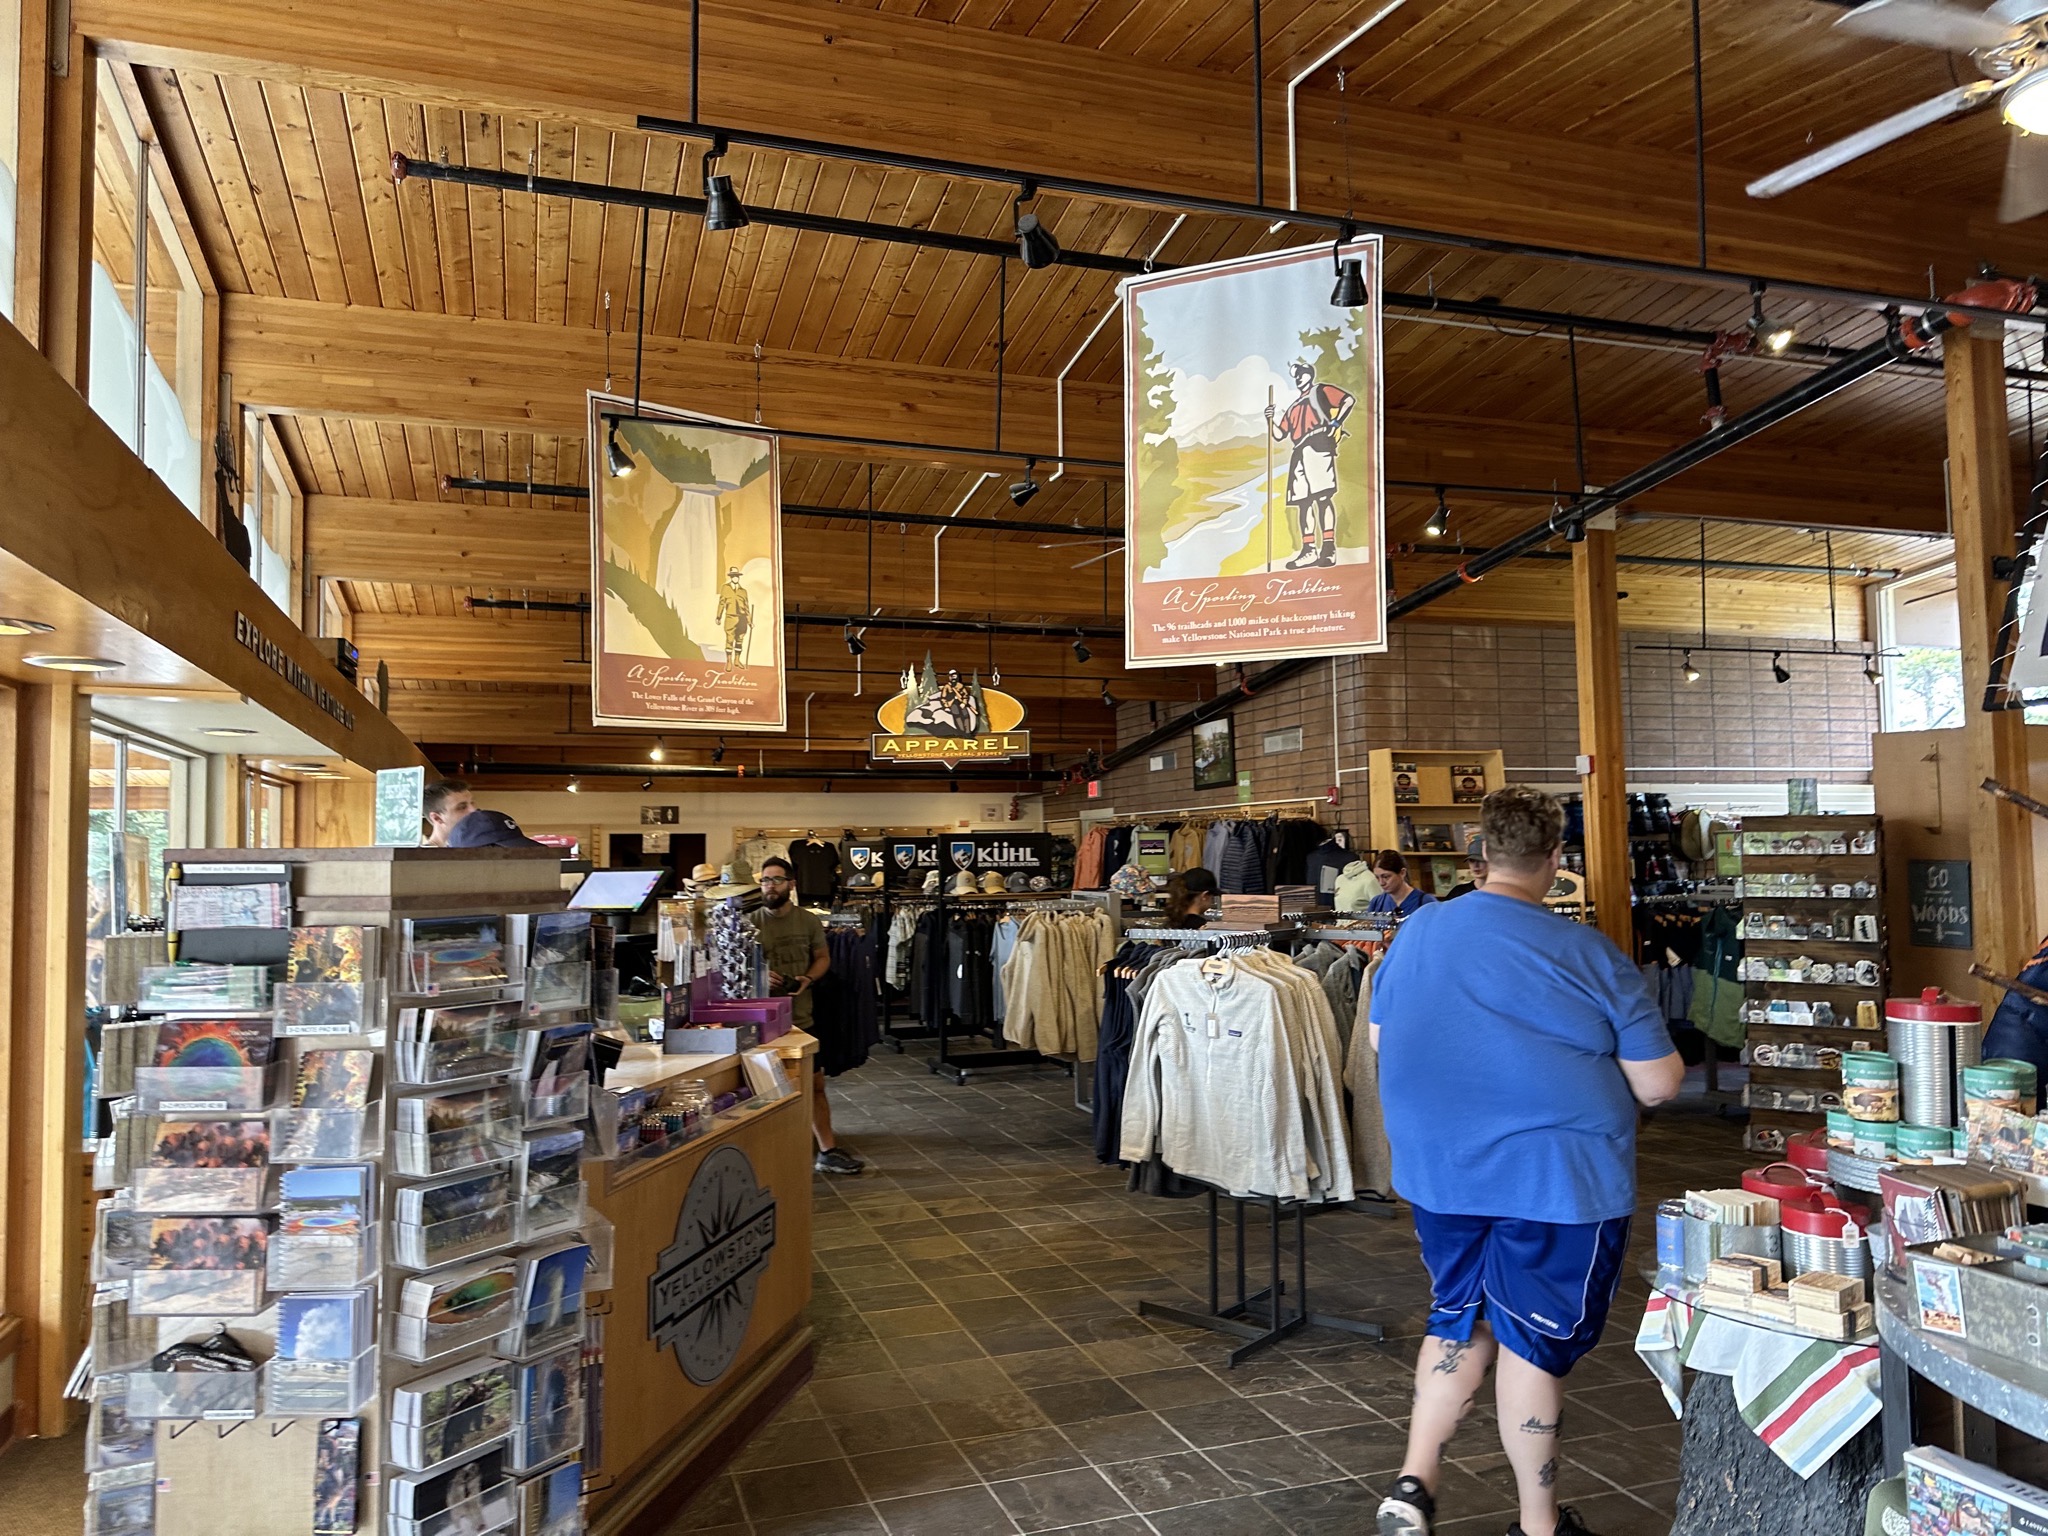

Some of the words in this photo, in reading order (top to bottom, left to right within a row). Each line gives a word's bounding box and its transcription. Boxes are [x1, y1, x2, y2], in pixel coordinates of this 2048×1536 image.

[1162, 586, 1184, 605] A
[1181, 582, 1257, 614] Sporting
[1264, 577, 1342, 604] Tradition
[1152, 623, 1166, 632] The
[1166, 622, 1176, 631] 96
[1177, 620, 1212, 630] trailheads
[1213, 618, 1227, 628] and
[1248, 616, 1269, 625] miles
[1270, 614, 1280, 623] of
[1281, 613, 1328, 623] backcountry
[1329, 609, 1356, 620] hiking
[1162, 635, 1180, 644] make
[1181, 632, 1228, 643] Yellowstone
[1228, 628, 1262, 639] National
[1263, 627, 1282, 637] Park
[1289, 627, 1305, 635] true
[1306, 624, 1346, 634] adventure.
[235, 609, 284, 676] EXPLORE
[285, 655, 316, 701] WITHIN
[627, 664, 645, 679] A
[642, 665, 699, 692] Sporting
[703, 669, 758, 689] Tradition
[631, 691, 643, 699] The
[644, 692, 662, 701] Lower
[662, 694, 678, 702] Falls
[696, 695, 715, 704] Grand
[715, 696, 738, 705] Canyon
[745, 698, 755, 706] the
[645, 702, 681, 711] Yellowstone
[681, 704, 698, 712] River
[726, 706, 741, 715] high.
[882, 736, 1020, 753] APPAREL
[977, 841, 1040, 862] KÜHL
[1928, 866, 1949, 889] GO
[1911, 905, 1970, 925] WOODS
[659, 1215, 772, 1306] YELLOWSTONE
[679, 1246, 758, 1309] ADVENTURES
